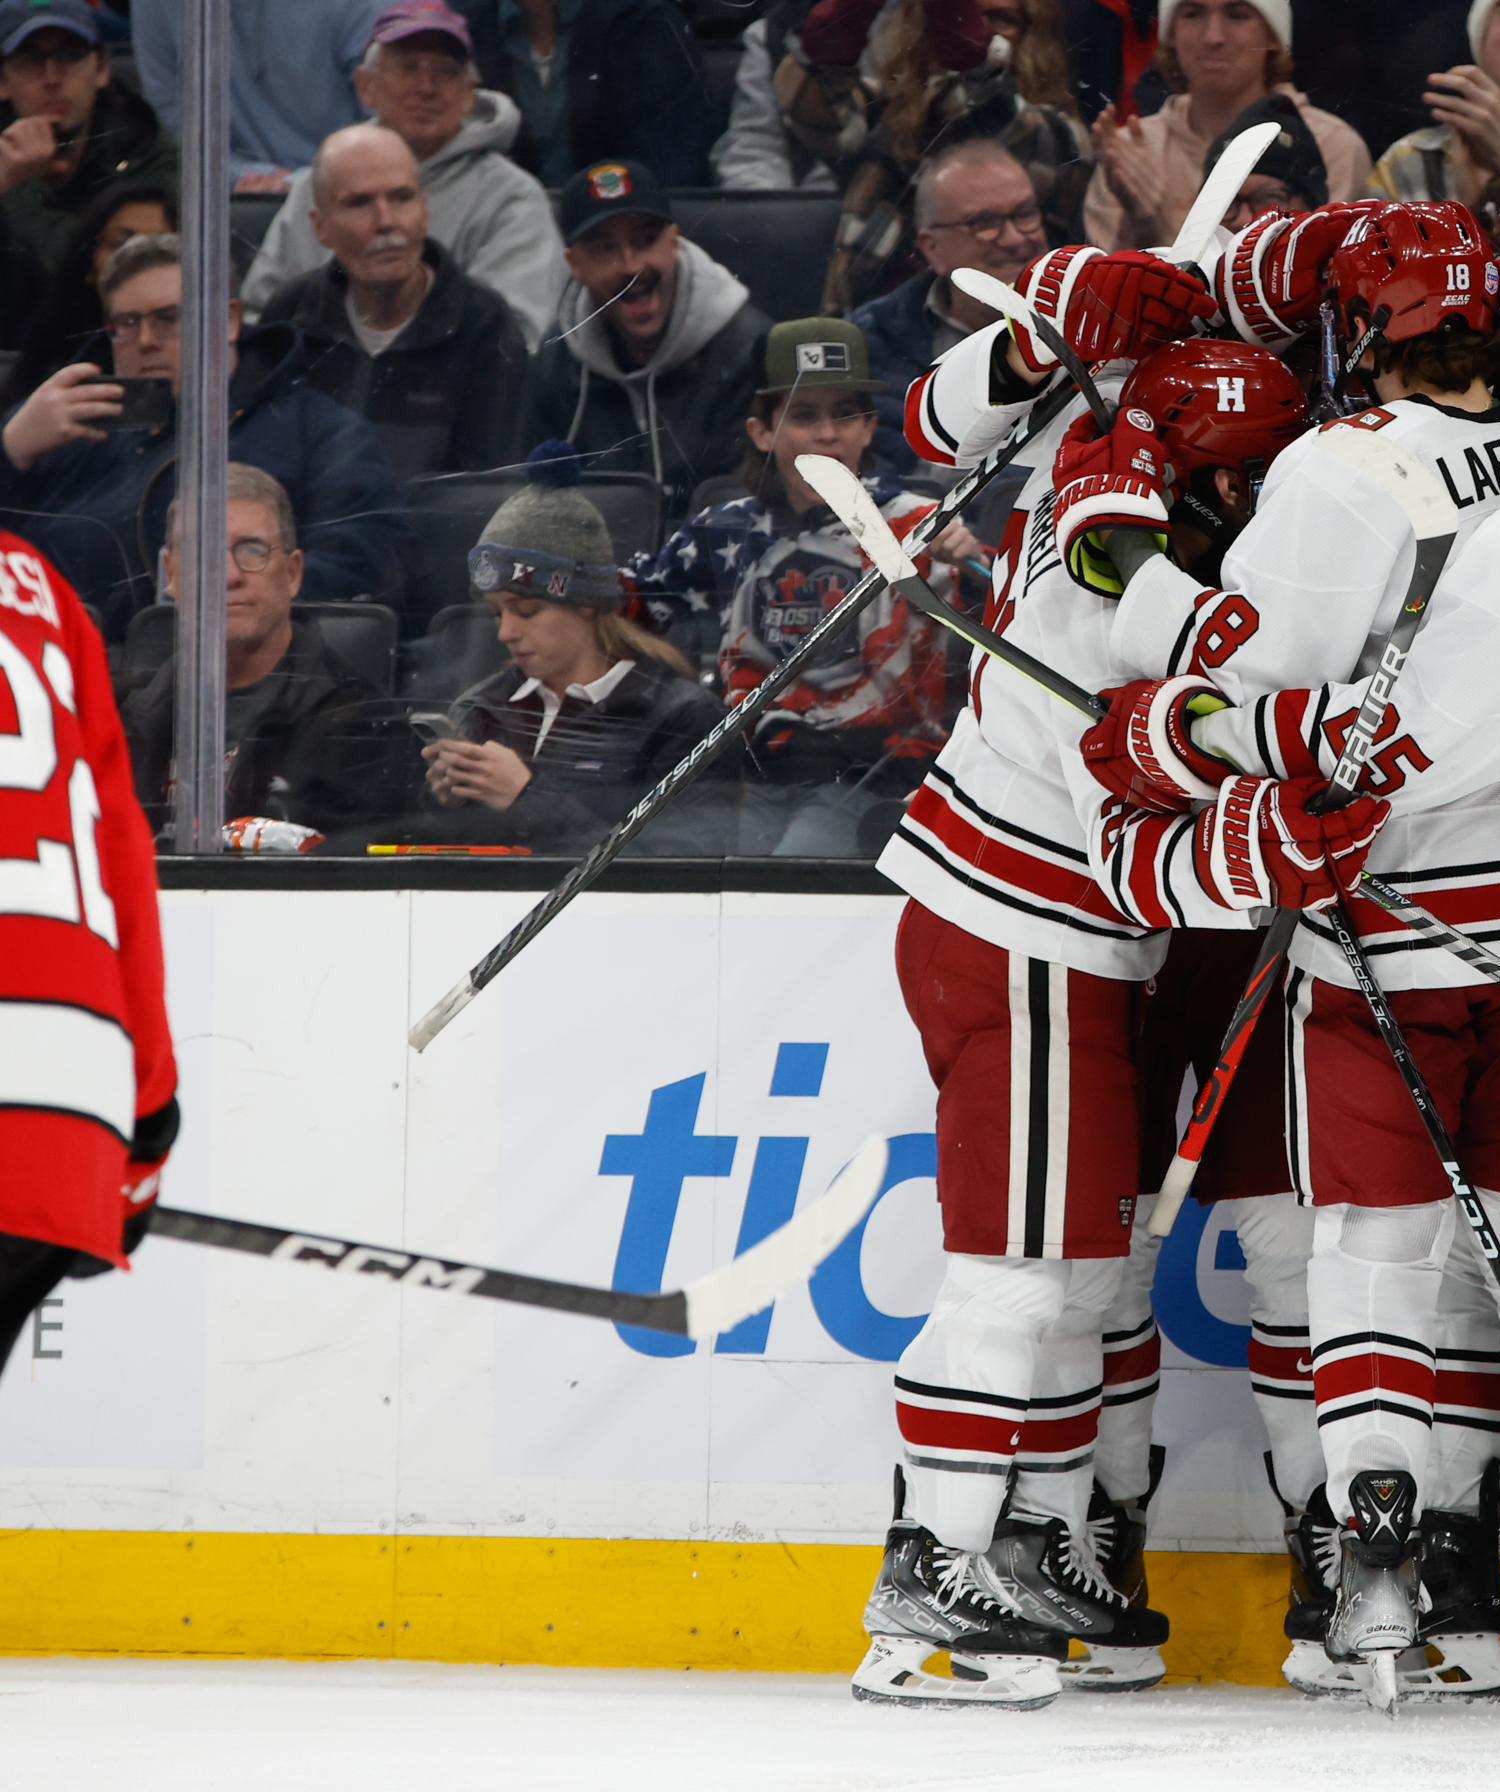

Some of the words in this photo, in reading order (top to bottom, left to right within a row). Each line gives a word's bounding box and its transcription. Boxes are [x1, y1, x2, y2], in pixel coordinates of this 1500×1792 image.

[1271, 260, 1279, 294] COVERT
[1445, 263, 1470, 291] 18
[1216, 376, 1245, 412] H
[1184, 492, 1223, 527] AUER
[1168, 707, 1188, 757] HARVARD
[617, 686, 763, 836] JETSPEED
[1203, 807, 1214, 852] HARVARD
[1371, 878, 1412, 905] ALPHA
[1338, 930, 1391, 1029] JETSPEED
[1442, 1161, 1499, 1260] CCM
[269, 1231, 489, 1296] CCM
